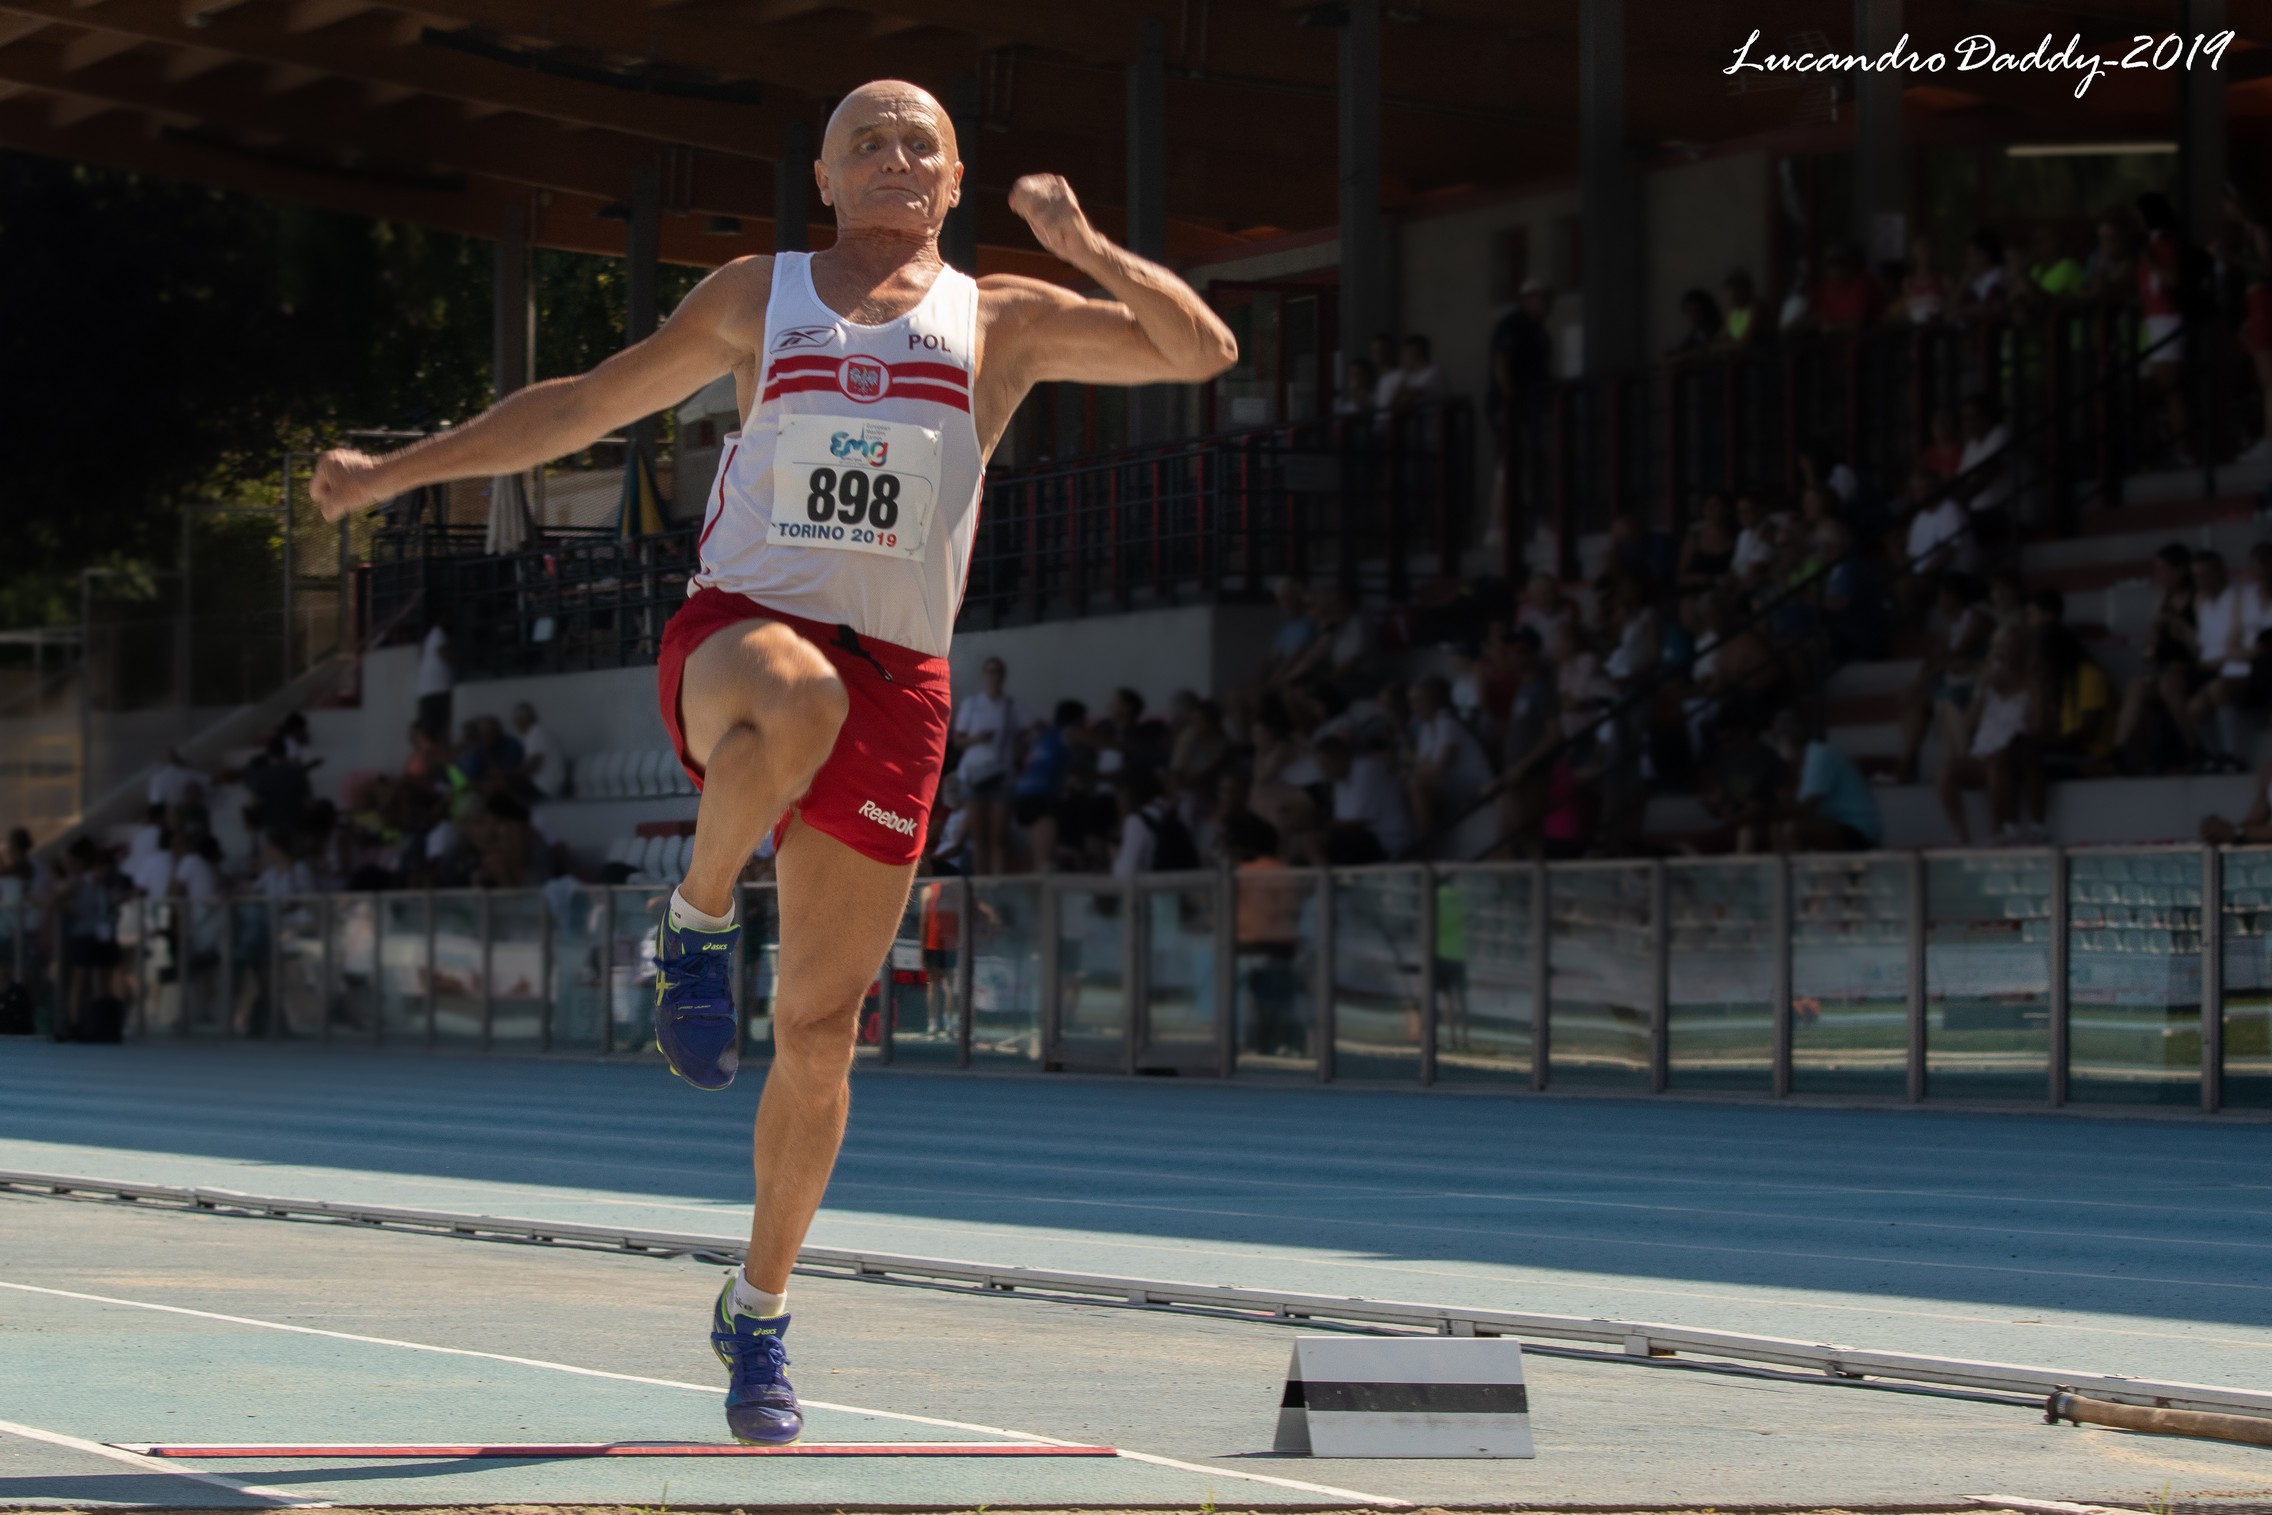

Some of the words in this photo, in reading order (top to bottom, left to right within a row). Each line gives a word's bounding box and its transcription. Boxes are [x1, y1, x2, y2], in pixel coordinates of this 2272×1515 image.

[908, 334, 951, 353] POL
[807, 467, 900, 529] 898
[779, 522, 845, 541] TORINO
[850, 528, 897, 548] 2019
[858, 799, 918, 838] Reebok
